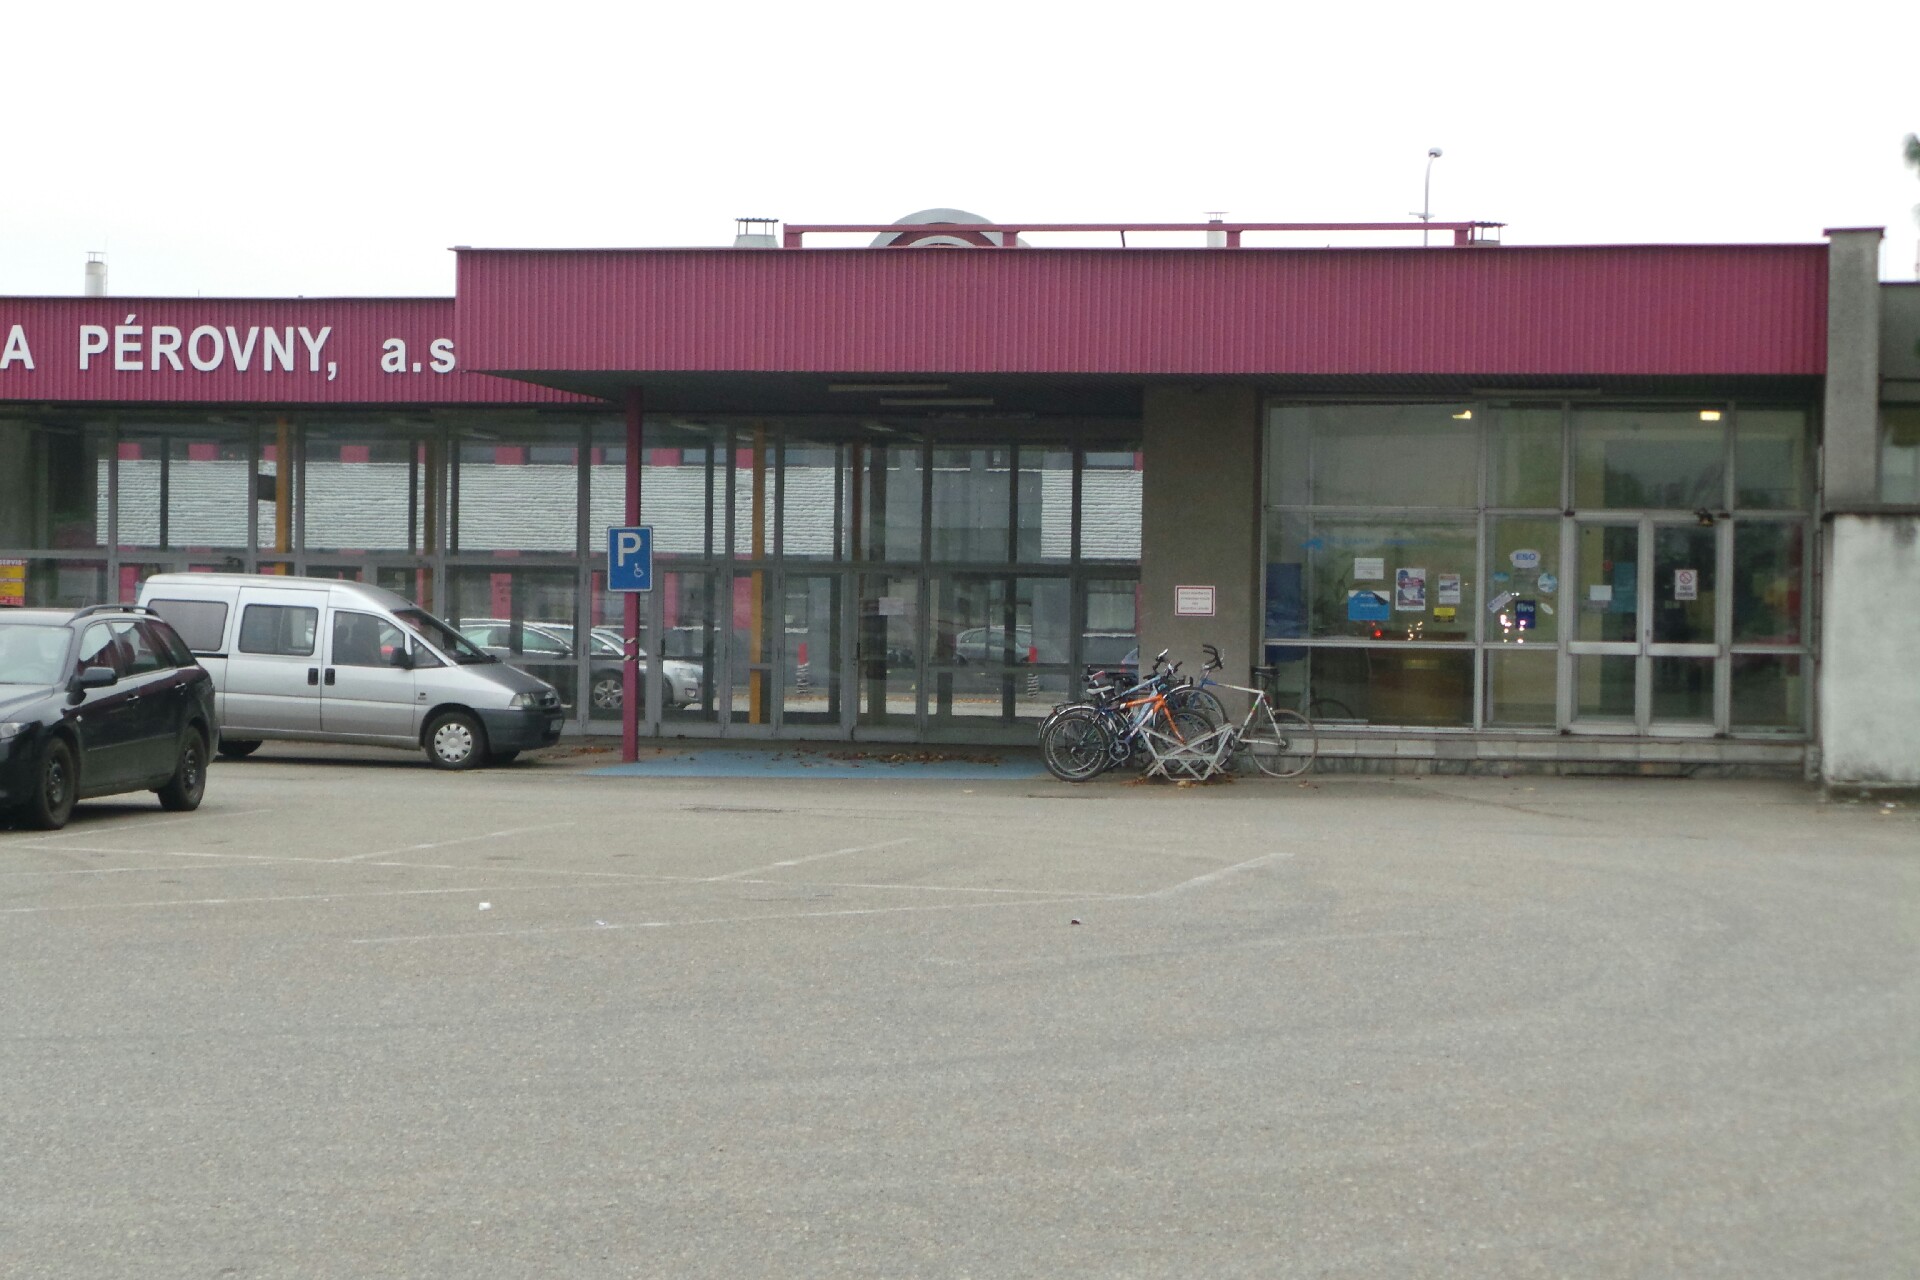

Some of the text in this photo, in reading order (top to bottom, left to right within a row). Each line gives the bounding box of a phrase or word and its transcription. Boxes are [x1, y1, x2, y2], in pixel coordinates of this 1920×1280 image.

[0, 324, 35, 370] A
[79, 314, 338, 381] PÉROVNY,
[617, 532, 642, 567] P
